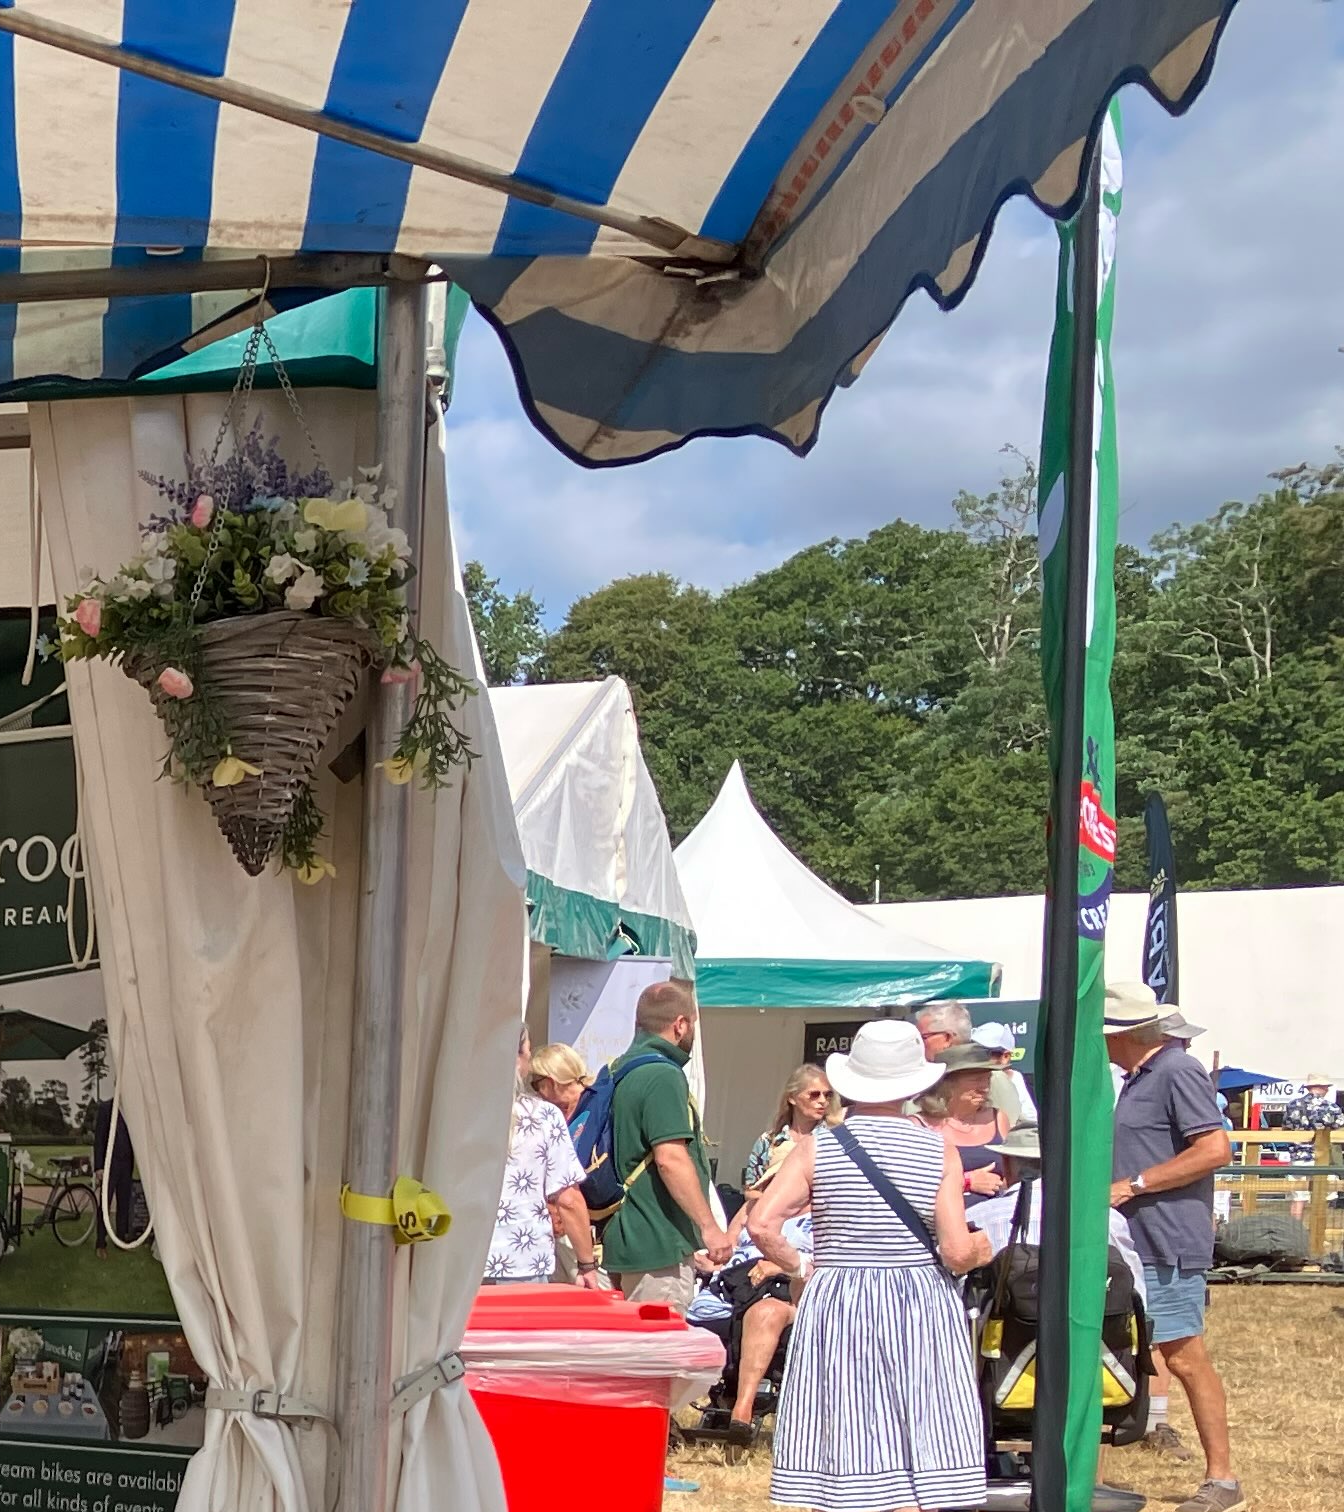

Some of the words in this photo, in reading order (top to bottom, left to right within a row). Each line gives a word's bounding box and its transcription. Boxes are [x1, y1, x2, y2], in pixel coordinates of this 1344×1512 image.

[1259, 1083, 1294, 1096] RING
[41, 1460, 82, 1484] bikes
[86, 1470, 113, 1488] are
[118, 1469, 182, 1493] availabl
[23, 1488, 42, 1509] all
[47, 1489, 89, 1512] kinds
